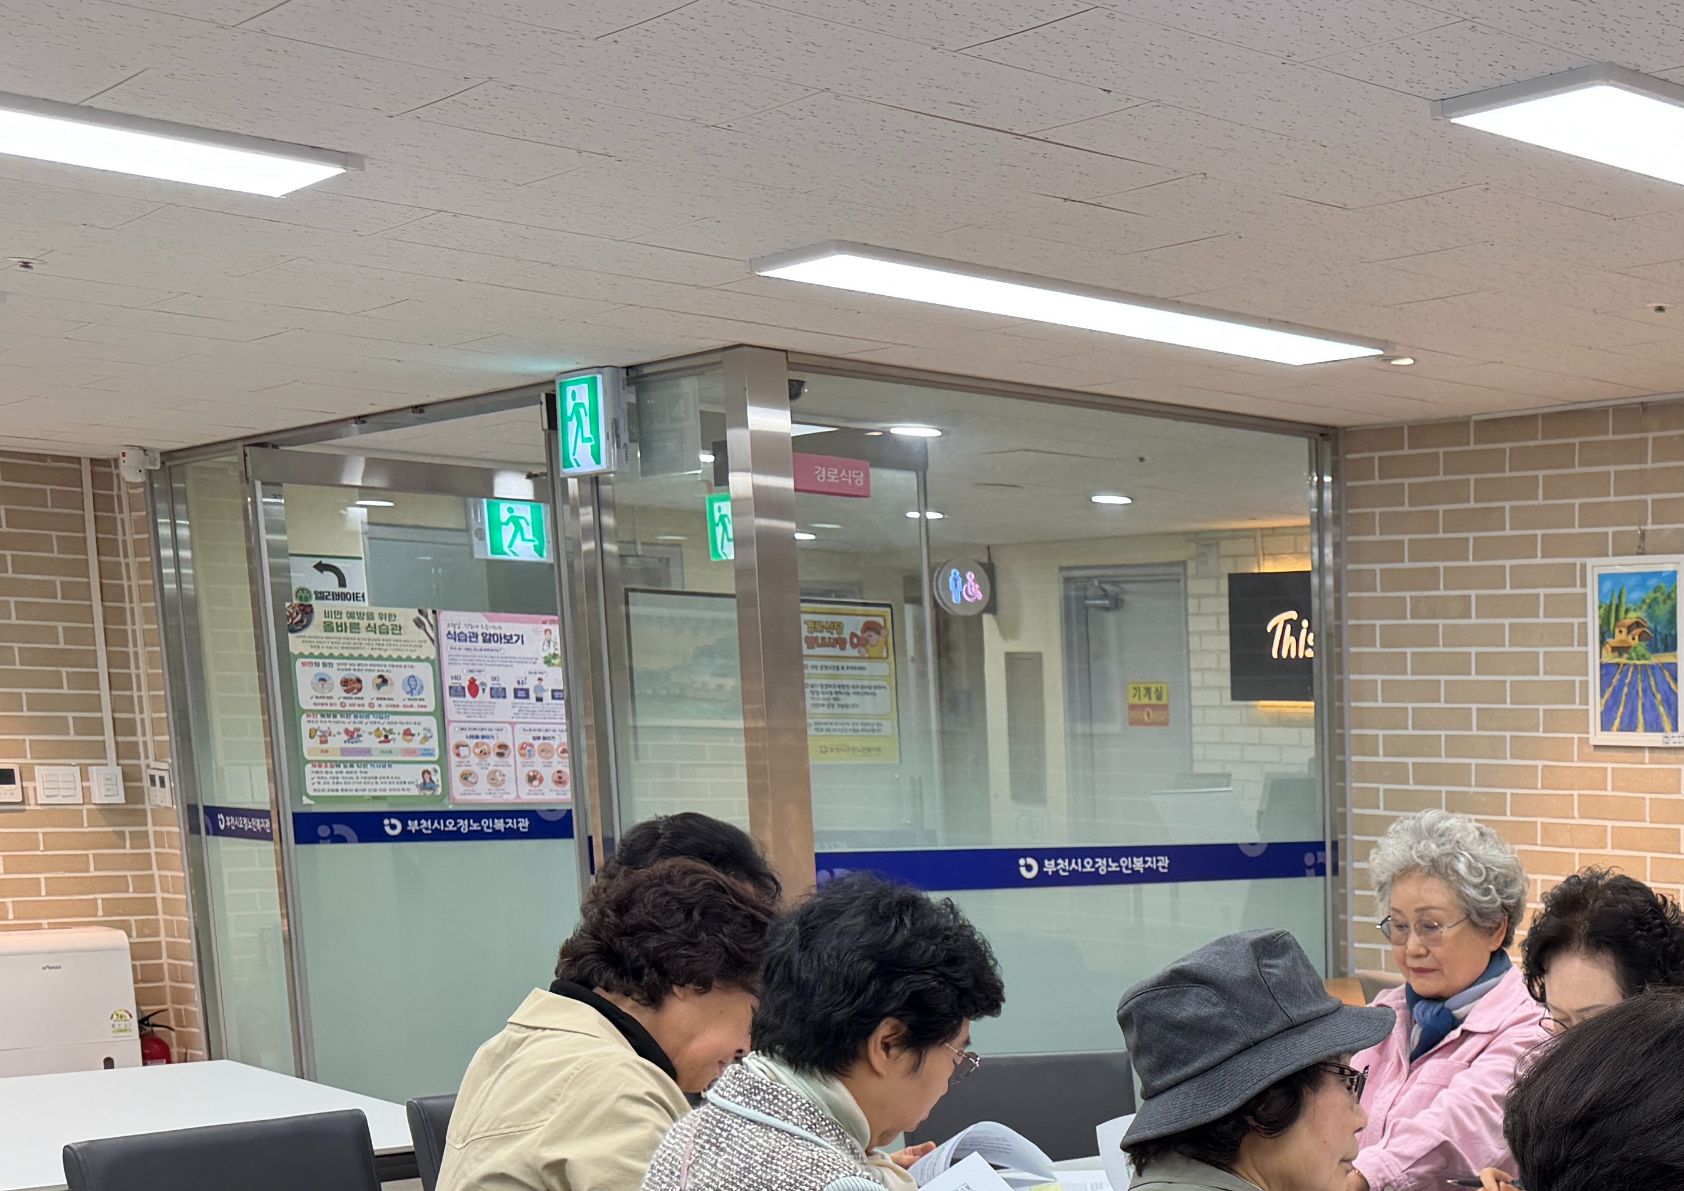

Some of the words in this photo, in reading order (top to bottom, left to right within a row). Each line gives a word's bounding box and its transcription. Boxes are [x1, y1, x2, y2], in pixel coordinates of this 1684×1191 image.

[814, 465, 865, 487] 경로식당
[314, 590, 365, 602] 엘리베이터
[324, 610, 342, 620] 비만
[346, 610, 375, 621] 예방을
[378, 612, 397, 622] 위한
[323, 621, 360, 633] 올바른
[365, 622, 402, 635] 식습관
[446, 630, 479, 643] 식습관
[481, 631, 524, 645] 알아보기
[1132, 685, 1163, 701] 기계실
[406, 817, 530, 834] 부천시오정노인복지관
[1043, 855, 1170, 876] 부천시오정노인복지관
